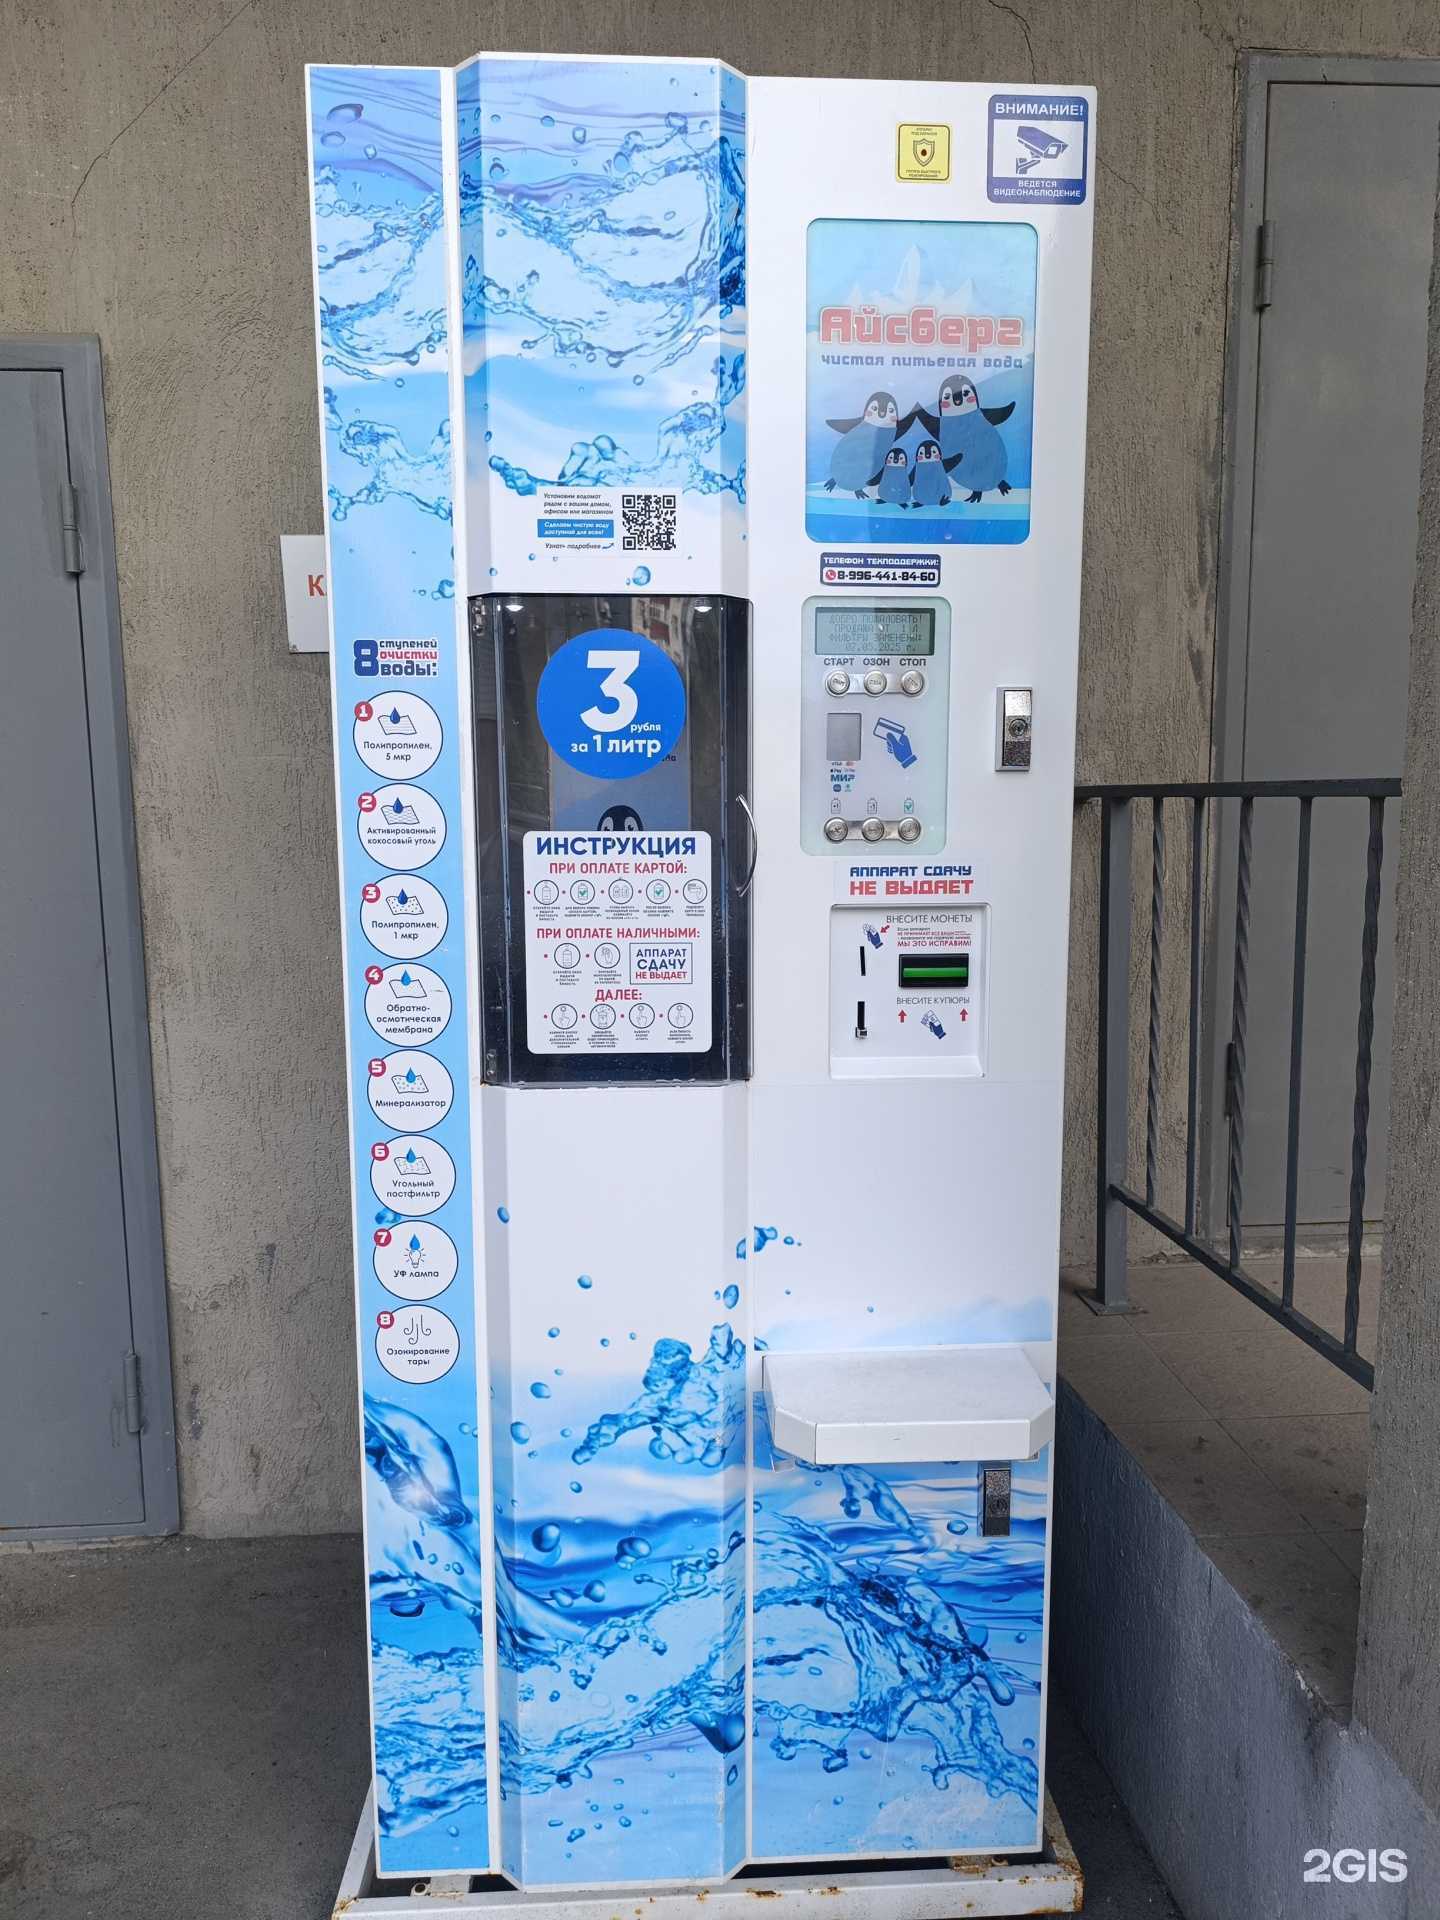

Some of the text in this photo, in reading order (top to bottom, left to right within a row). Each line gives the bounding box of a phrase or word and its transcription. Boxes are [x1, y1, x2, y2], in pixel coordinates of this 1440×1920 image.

[995, 103, 1083, 116] ВНИМАНИЕ!
[1019, 180, 1057, 188] ВЕДЕТСЯ
[994, 188, 1081, 198] ВИДЕОНАБЛЮДЕНИЕ
[820, 304, 1024, 353] Айсберг
[821, 354, 1023, 369] чистая питьевая вода
[824, 557, 939, 566] ТЕЛЕФОН ТЕХПОДДЕРЖКИ:
[838, 571, 936, 581] 8-996-441-84-60
[380, 639, 437, 650] ступеней
[354, 640, 379, 676] 8
[380, 650, 437, 660] очистки
[381, 660, 437, 676] воды:
[824, 658, 926, 666] СТАРТ ОЗОН СТОП
[580, 651, 640, 732] 3
[360, 705, 368, 718] 1
[630, 722, 661, 733] рубля
[571, 742, 588, 752] за
[592, 735, 602, 752] 1
[607, 739, 662, 758] литр
[393, 754, 411, 762] мкр
[361, 795, 373, 808] 2
[367, 827, 436, 835] Активированный
[536, 837, 696, 858] ИНСТРУКЦИЯ
[549, 860, 688, 874] ПРИ ОПЛАТЕ КАРТОЙ:
[850, 865, 972, 877] АППАРАТ СДАЧУ
[365, 887, 376, 899] 3
[849, 879, 974, 896] НЕ ВЫДАЕТ
[886, 914, 973, 924] ВНЕСИТЕ МОНЕТЫ
[400, 933, 419, 941] мкр
[537, 928, 700, 939] ПРИ ОПЛАТЕ НАЛИЧНЫМИ:
[636, 949, 687, 957] АППАРАТ
[637, 959, 686, 971] СДАЧУ
[368, 969, 379, 981] 4
[649, 971, 688, 980] ВЫДАЕТ
[595, 989, 642, 1002] ДАЛЕЕ:
[897, 997, 970, 1005] ВНЕСИТЕ КУПЮРЫ
[386, 1004, 430, 1013] Обратно-
[385, 1026, 433, 1034] мембрана
[371, 1061, 382, 1073] 5
[374, 1145, 385, 1157] 6
[386, 1190, 440, 1199] постфильтр
[376, 1231, 387, 1243] 7
[380, 1313, 390, 1325] 8
[386, 1348, 450, 1356] Озонирование
